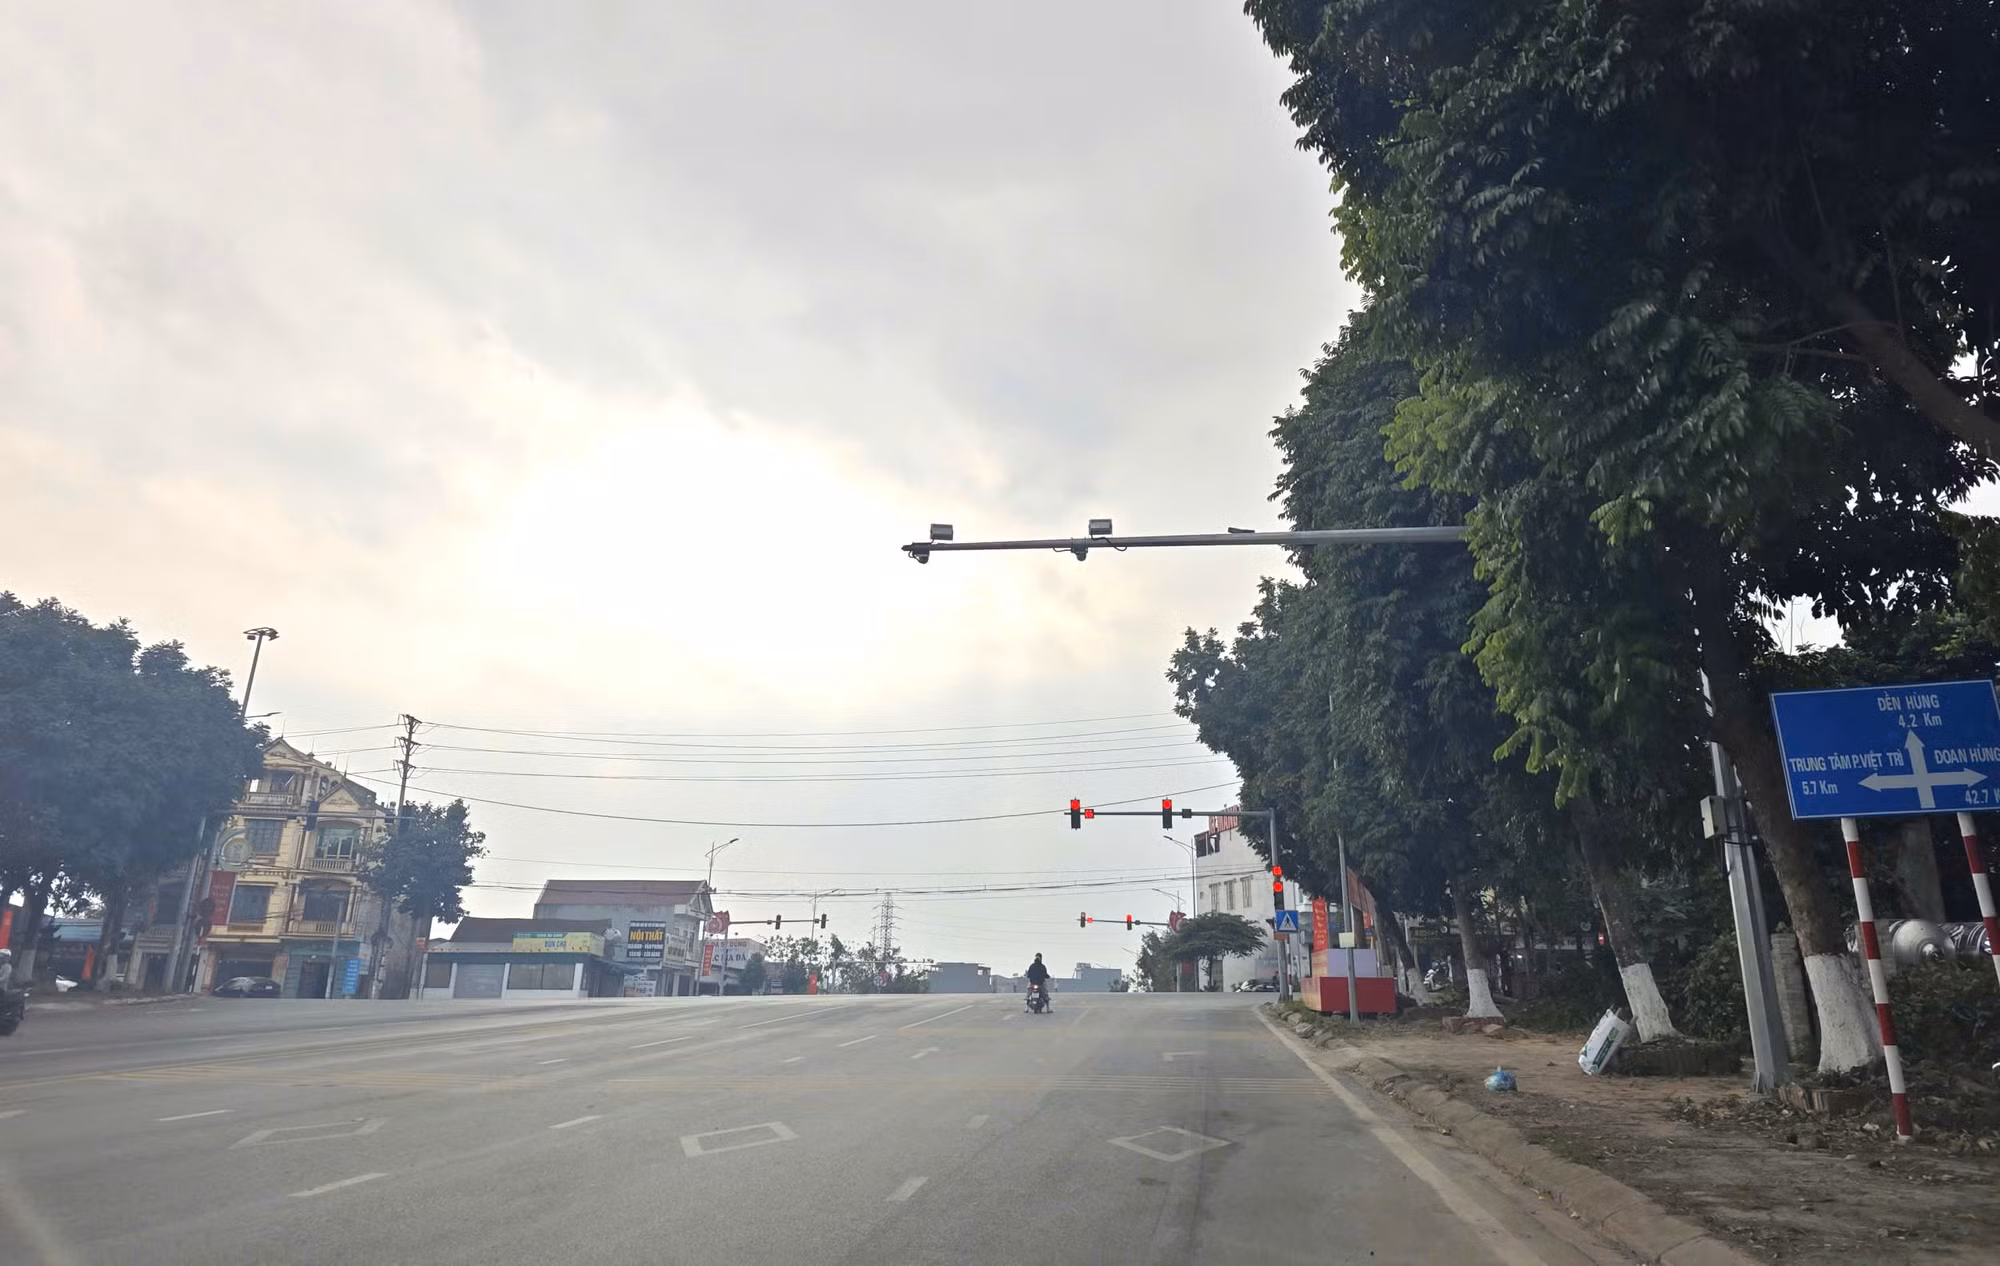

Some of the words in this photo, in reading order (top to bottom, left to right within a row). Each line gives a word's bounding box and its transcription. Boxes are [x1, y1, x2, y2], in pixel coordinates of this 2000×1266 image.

[1877, 692, 1901, 711] ĐỀN
[1905, 692, 1940, 710] HÙNG
[1898, 714, 1918, 728] 4.2
[1923, 712, 1942, 726] Km
[1789, 757, 1827, 772] TRUNG
[1828, 752, 1852, 770] TÂM
[1886, 749, 1905, 767] TRÌ
[1934, 748, 1968, 764] ĐOAN
[1802, 782, 1817, 795] 5.7
[1819, 780, 1838, 794] Km
[1965, 789, 1989, 804] 42.7
